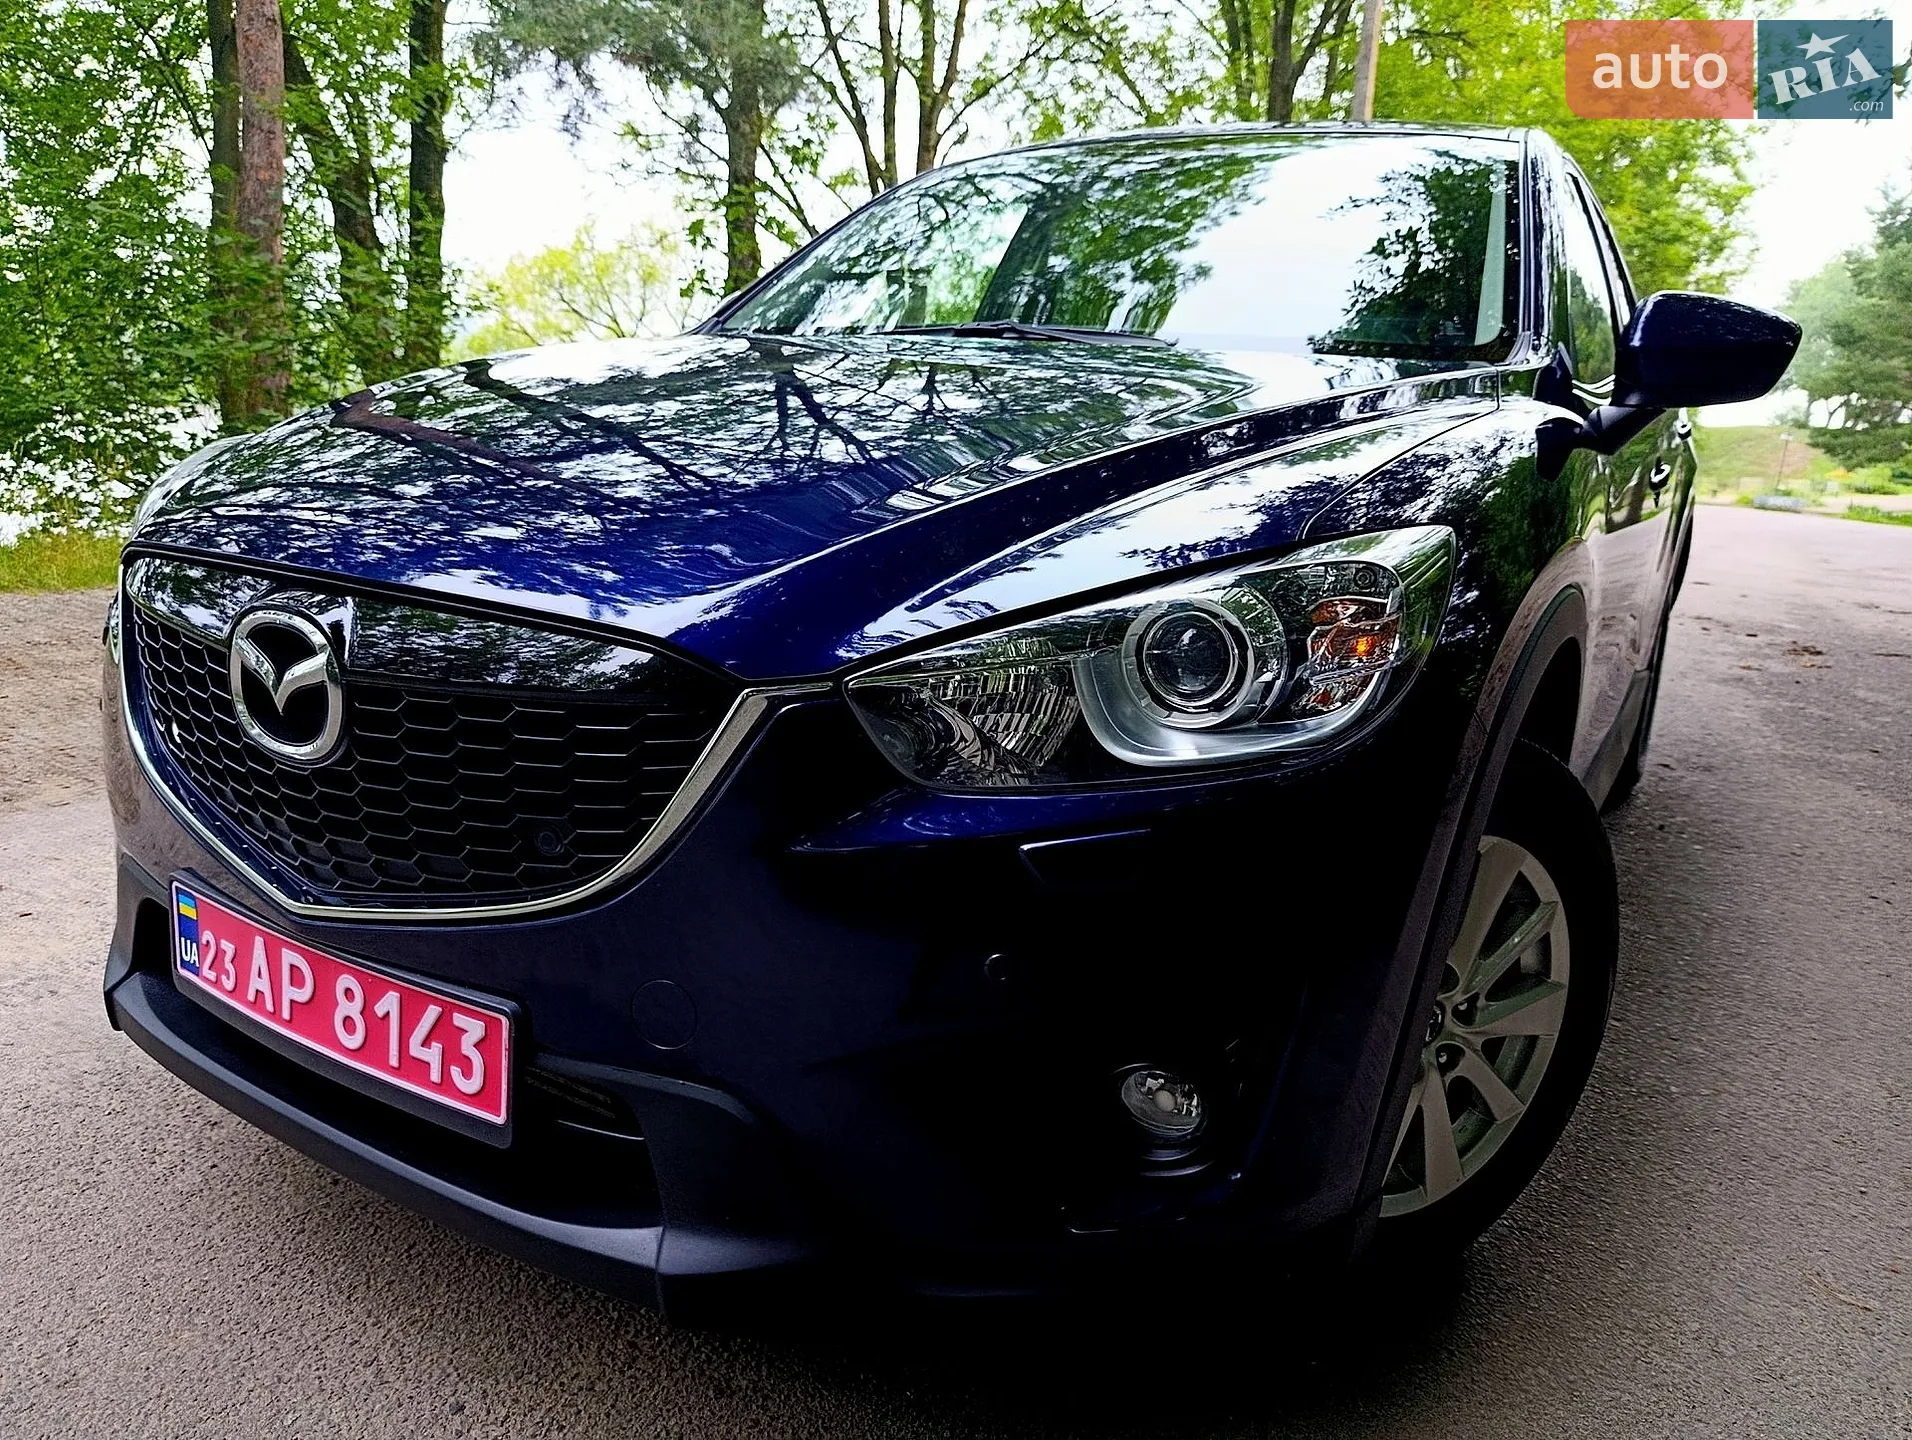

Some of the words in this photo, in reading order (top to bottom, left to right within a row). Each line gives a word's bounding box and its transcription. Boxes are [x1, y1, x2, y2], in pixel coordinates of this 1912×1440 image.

[181, 937, 200, 967] UA
[201, 930, 236, 992] 23
[247, 935, 315, 1022] AP
[333, 973, 486, 1095] 8143
